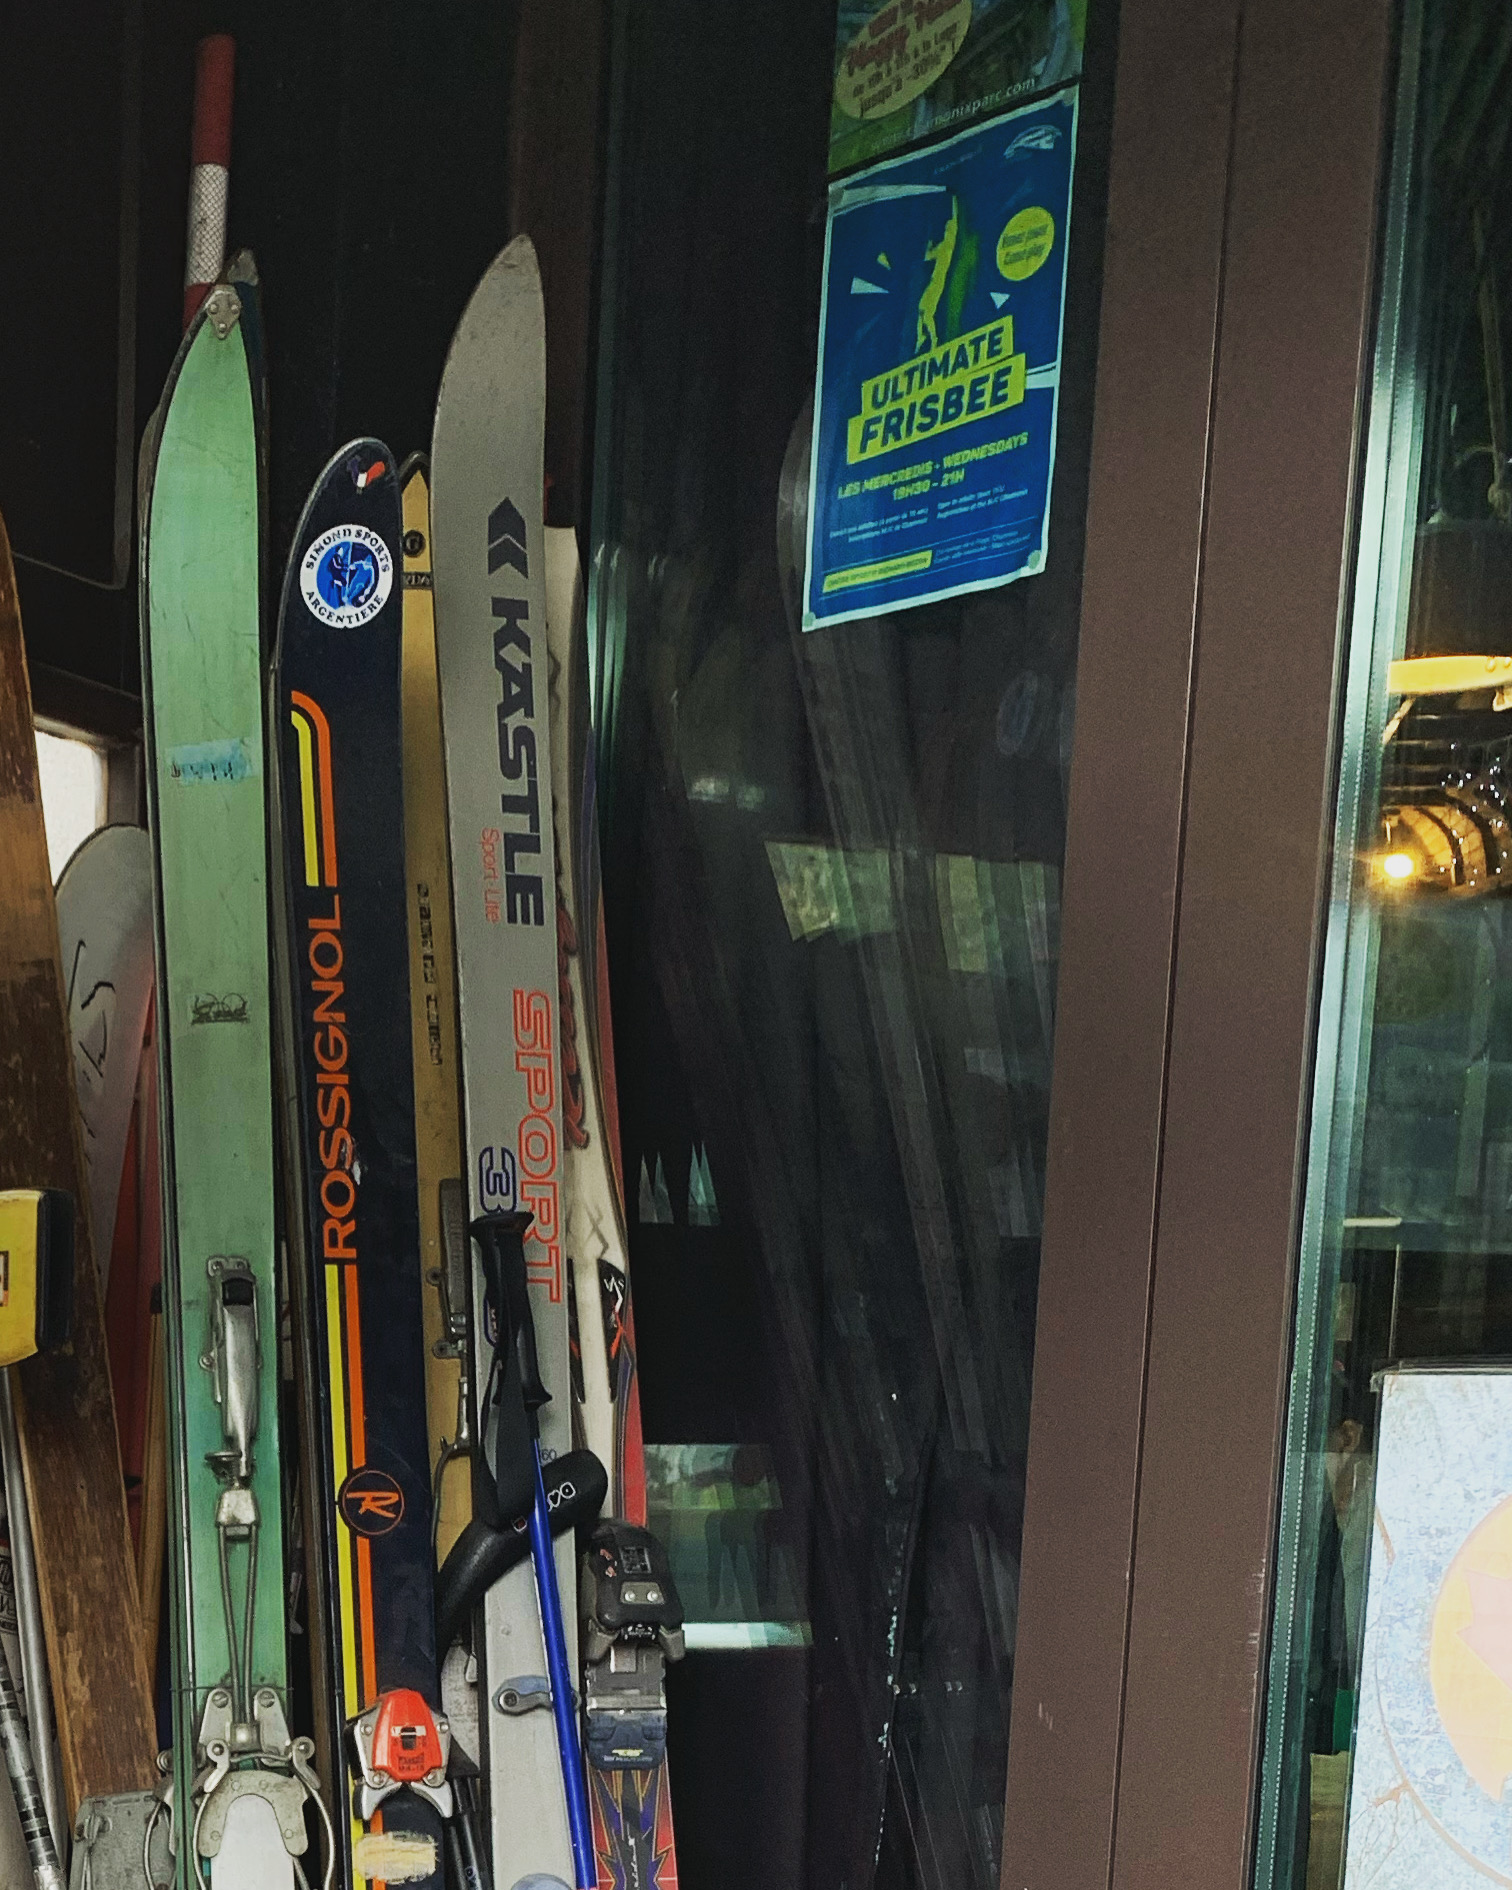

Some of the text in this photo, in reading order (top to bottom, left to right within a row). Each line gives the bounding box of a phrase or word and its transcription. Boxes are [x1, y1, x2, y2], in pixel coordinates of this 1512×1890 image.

[858, 363, 1015, 455] FRISBEE
[869, 322, 1005, 411] ULTIMATE
[305, 528, 390, 573] SIMOND SPORTS
[305, 590, 384, 625] ARGENTIERE
[308, 893, 357, 1259] ROSSIGNOL
[512, 988, 562, 1304] SPORT
